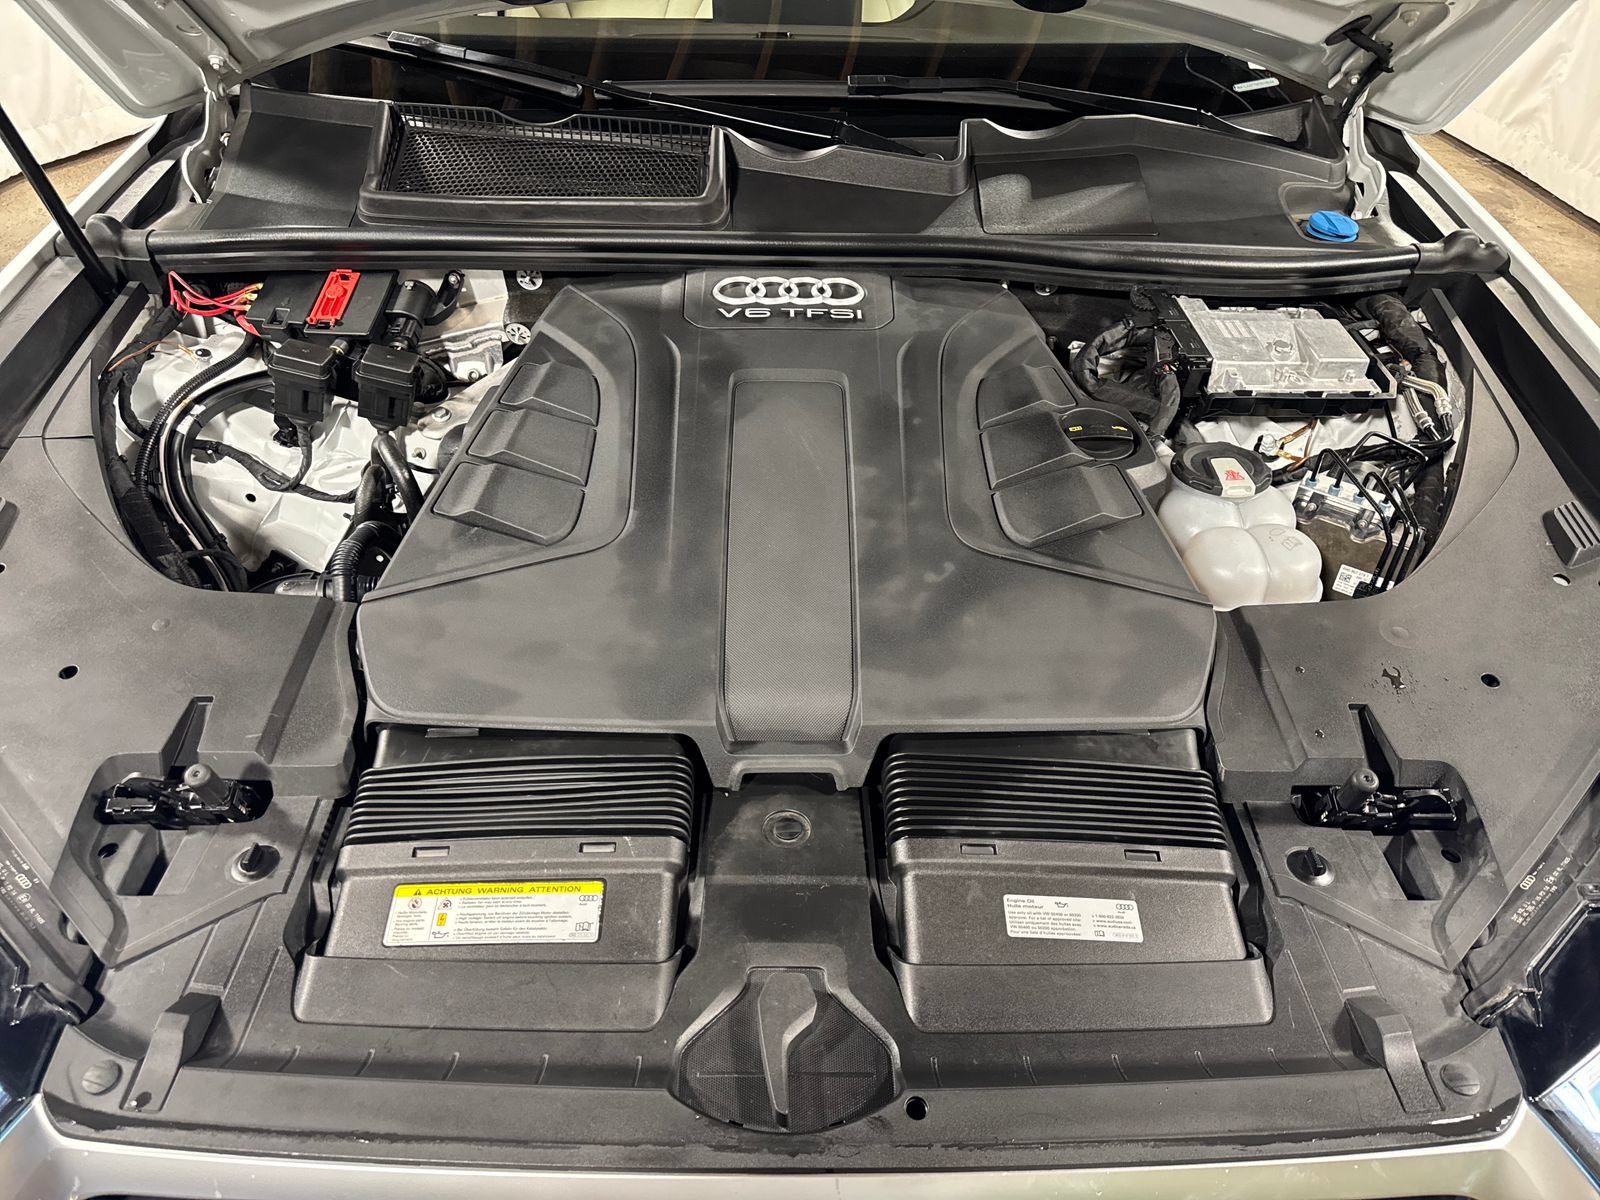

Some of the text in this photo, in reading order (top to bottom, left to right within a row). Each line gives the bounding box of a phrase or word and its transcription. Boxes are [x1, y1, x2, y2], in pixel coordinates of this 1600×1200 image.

[717, 308, 863, 319] V6 TFSI
[426, 885, 582, 896] ACHTUNG WARNING ATTENTION
